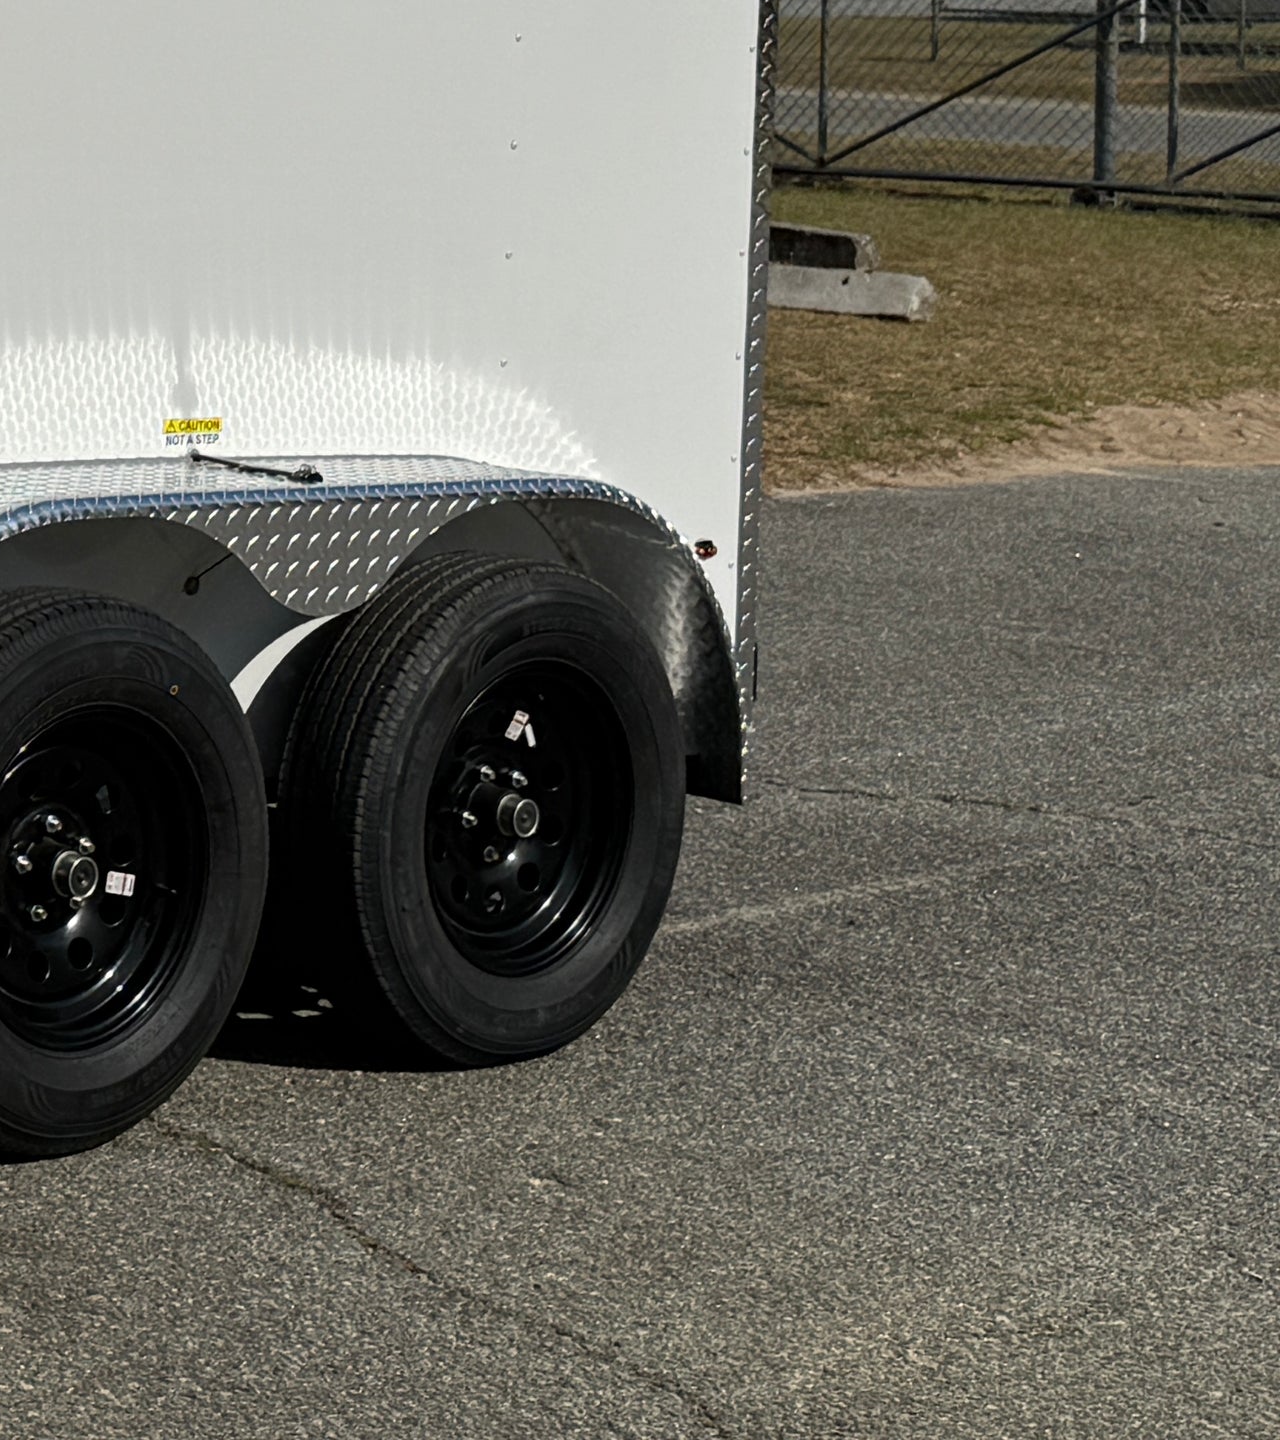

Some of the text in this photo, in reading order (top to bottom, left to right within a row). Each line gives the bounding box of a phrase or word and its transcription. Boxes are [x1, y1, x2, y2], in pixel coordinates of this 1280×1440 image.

[179, 419, 220, 431] CAUTION
[165, 434, 219, 446] NOT A STEP
